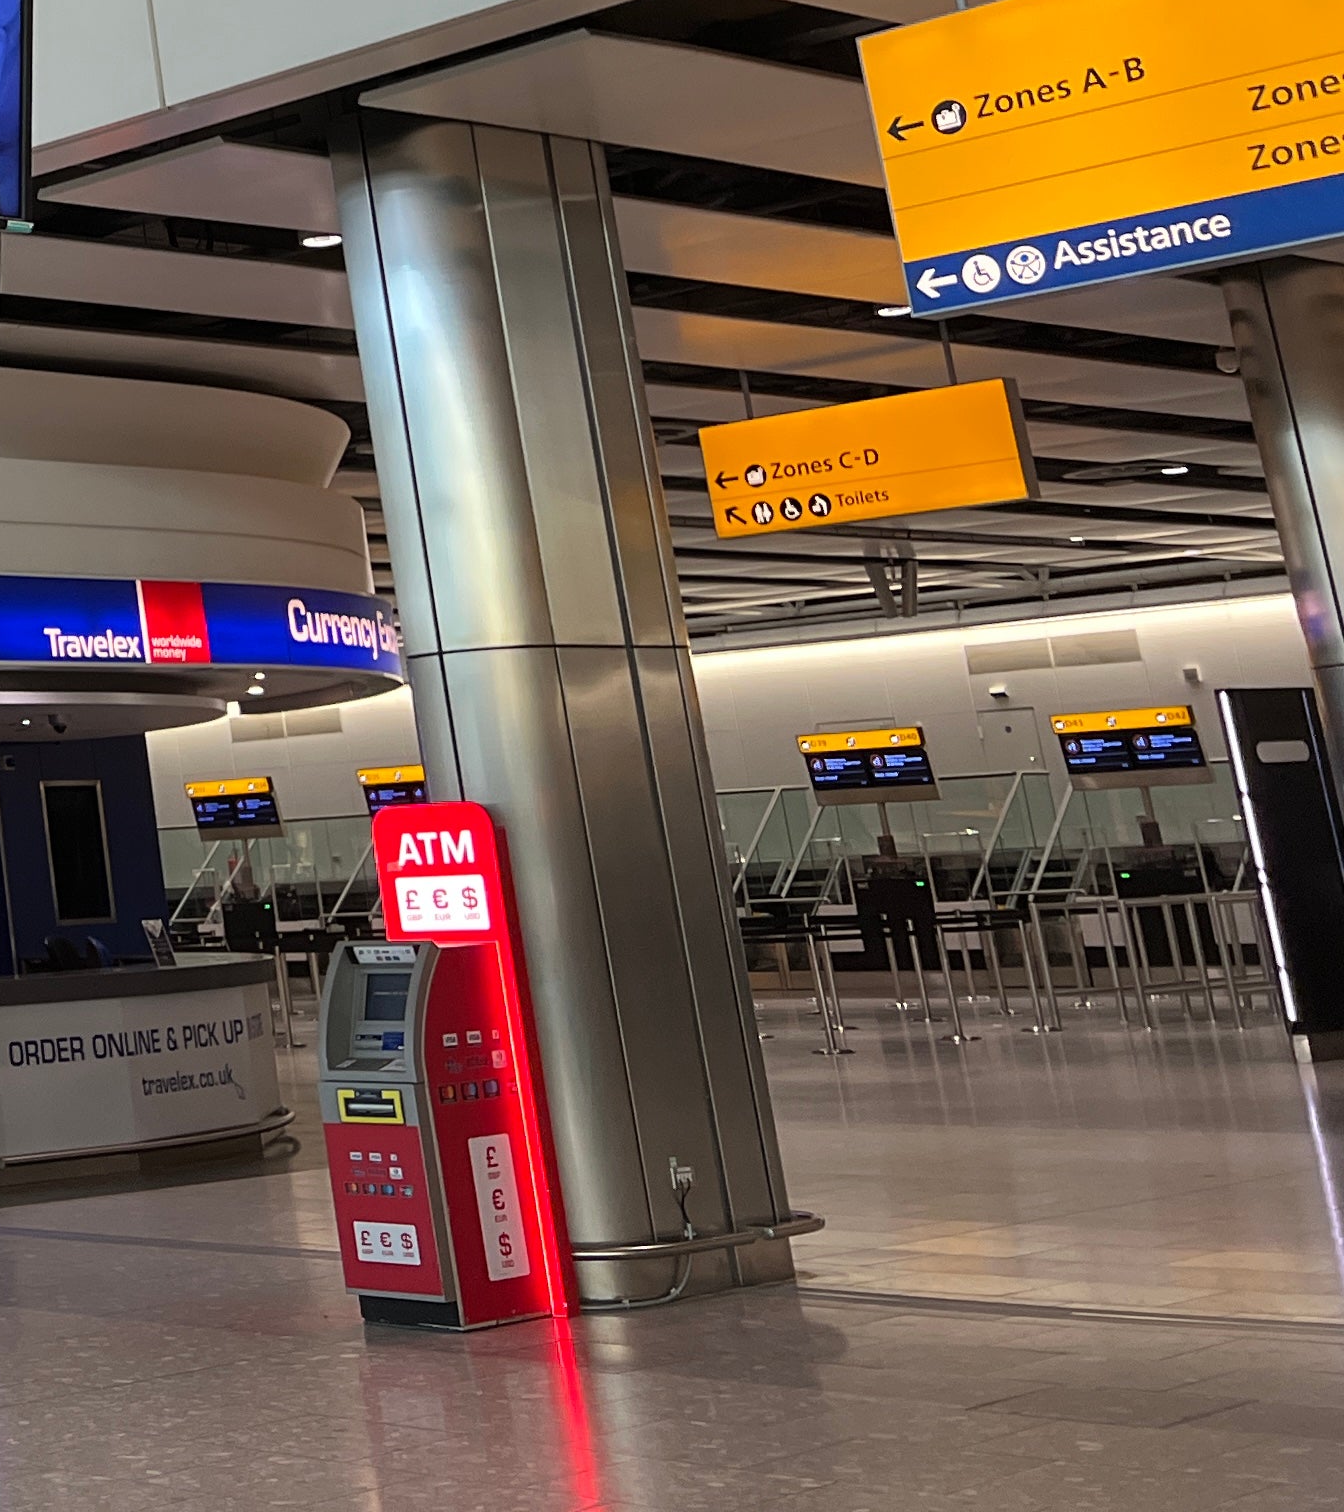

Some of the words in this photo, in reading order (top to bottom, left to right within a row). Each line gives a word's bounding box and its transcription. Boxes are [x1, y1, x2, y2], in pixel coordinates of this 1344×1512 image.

[973, 78, 1072, 120] Zones
[1247, 74, 1344, 111] Zone
[1247, 134, 1344, 171] Zone
[1053, 211, 1231, 271] Assistance
[771, 456, 834, 480] Zones
[835, 488, 890, 508] Toilets
[43, 627, 143, 659] Travelex
[151, 635, 203, 650] worldwide
[287, 598, 378, 661] Currency
[152, 647, 187, 662] money
[398, 829, 475, 866] ATM
[406, 890, 420, 910] £
[432, 889, 449, 909] €
[461, 886, 478, 910] $
[9, 1036, 85, 1067] ORDER
[92, 1029, 162, 1060] ONLINE
[166, 1027, 178, 1051] &
[182, 1021, 220, 1050] PICK
[223, 1019, 244, 1044] UP
[142, 1063, 235, 1096] travelex.co.uk
